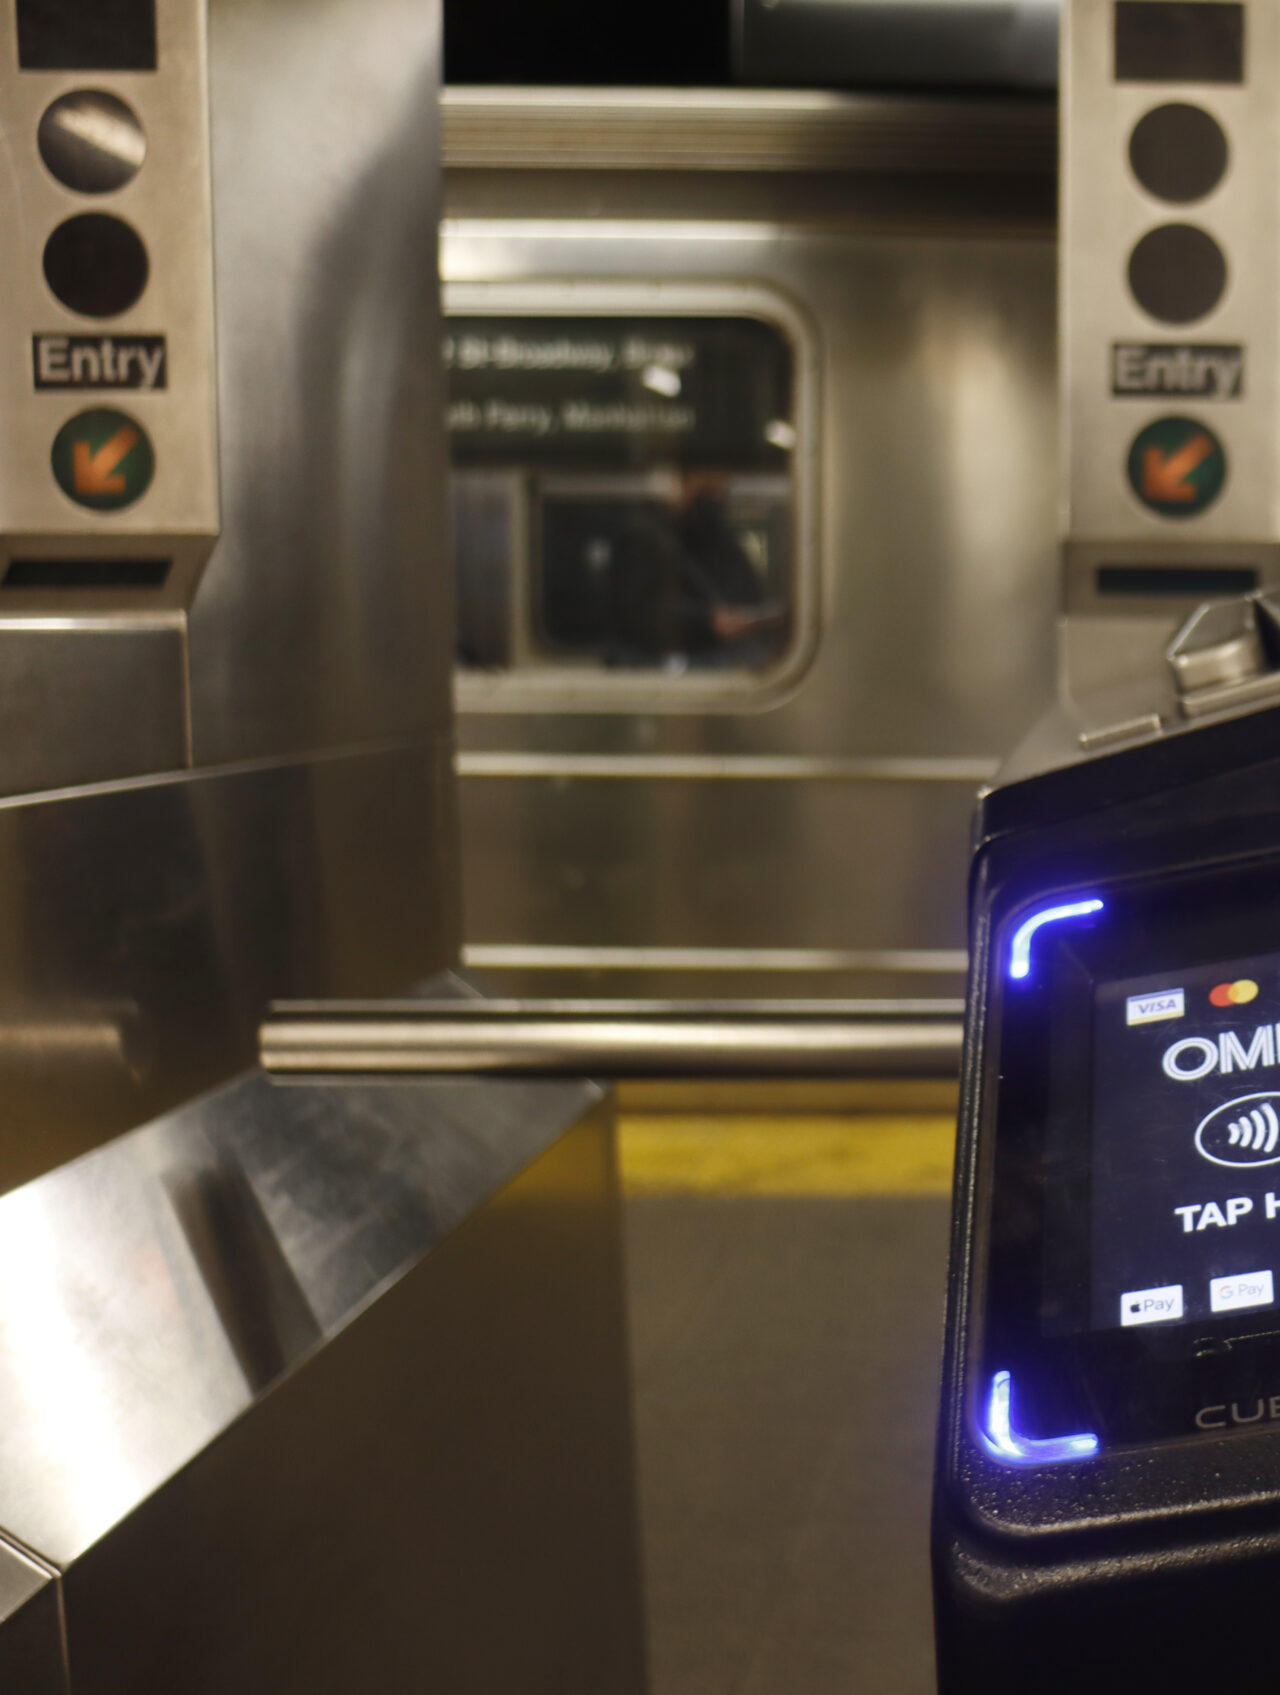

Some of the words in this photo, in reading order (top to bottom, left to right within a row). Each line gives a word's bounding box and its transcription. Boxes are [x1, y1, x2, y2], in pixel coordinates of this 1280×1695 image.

[38, 337, 165, 392] Entry
[1116, 346, 1241, 399] Entry
[1137, 998, 1177, 1015] VISA
[1174, 1196, 1254, 1233] TAP
[1238, 1283, 1265, 1297] Pay
[1143, 1298, 1175, 1312] Pay
